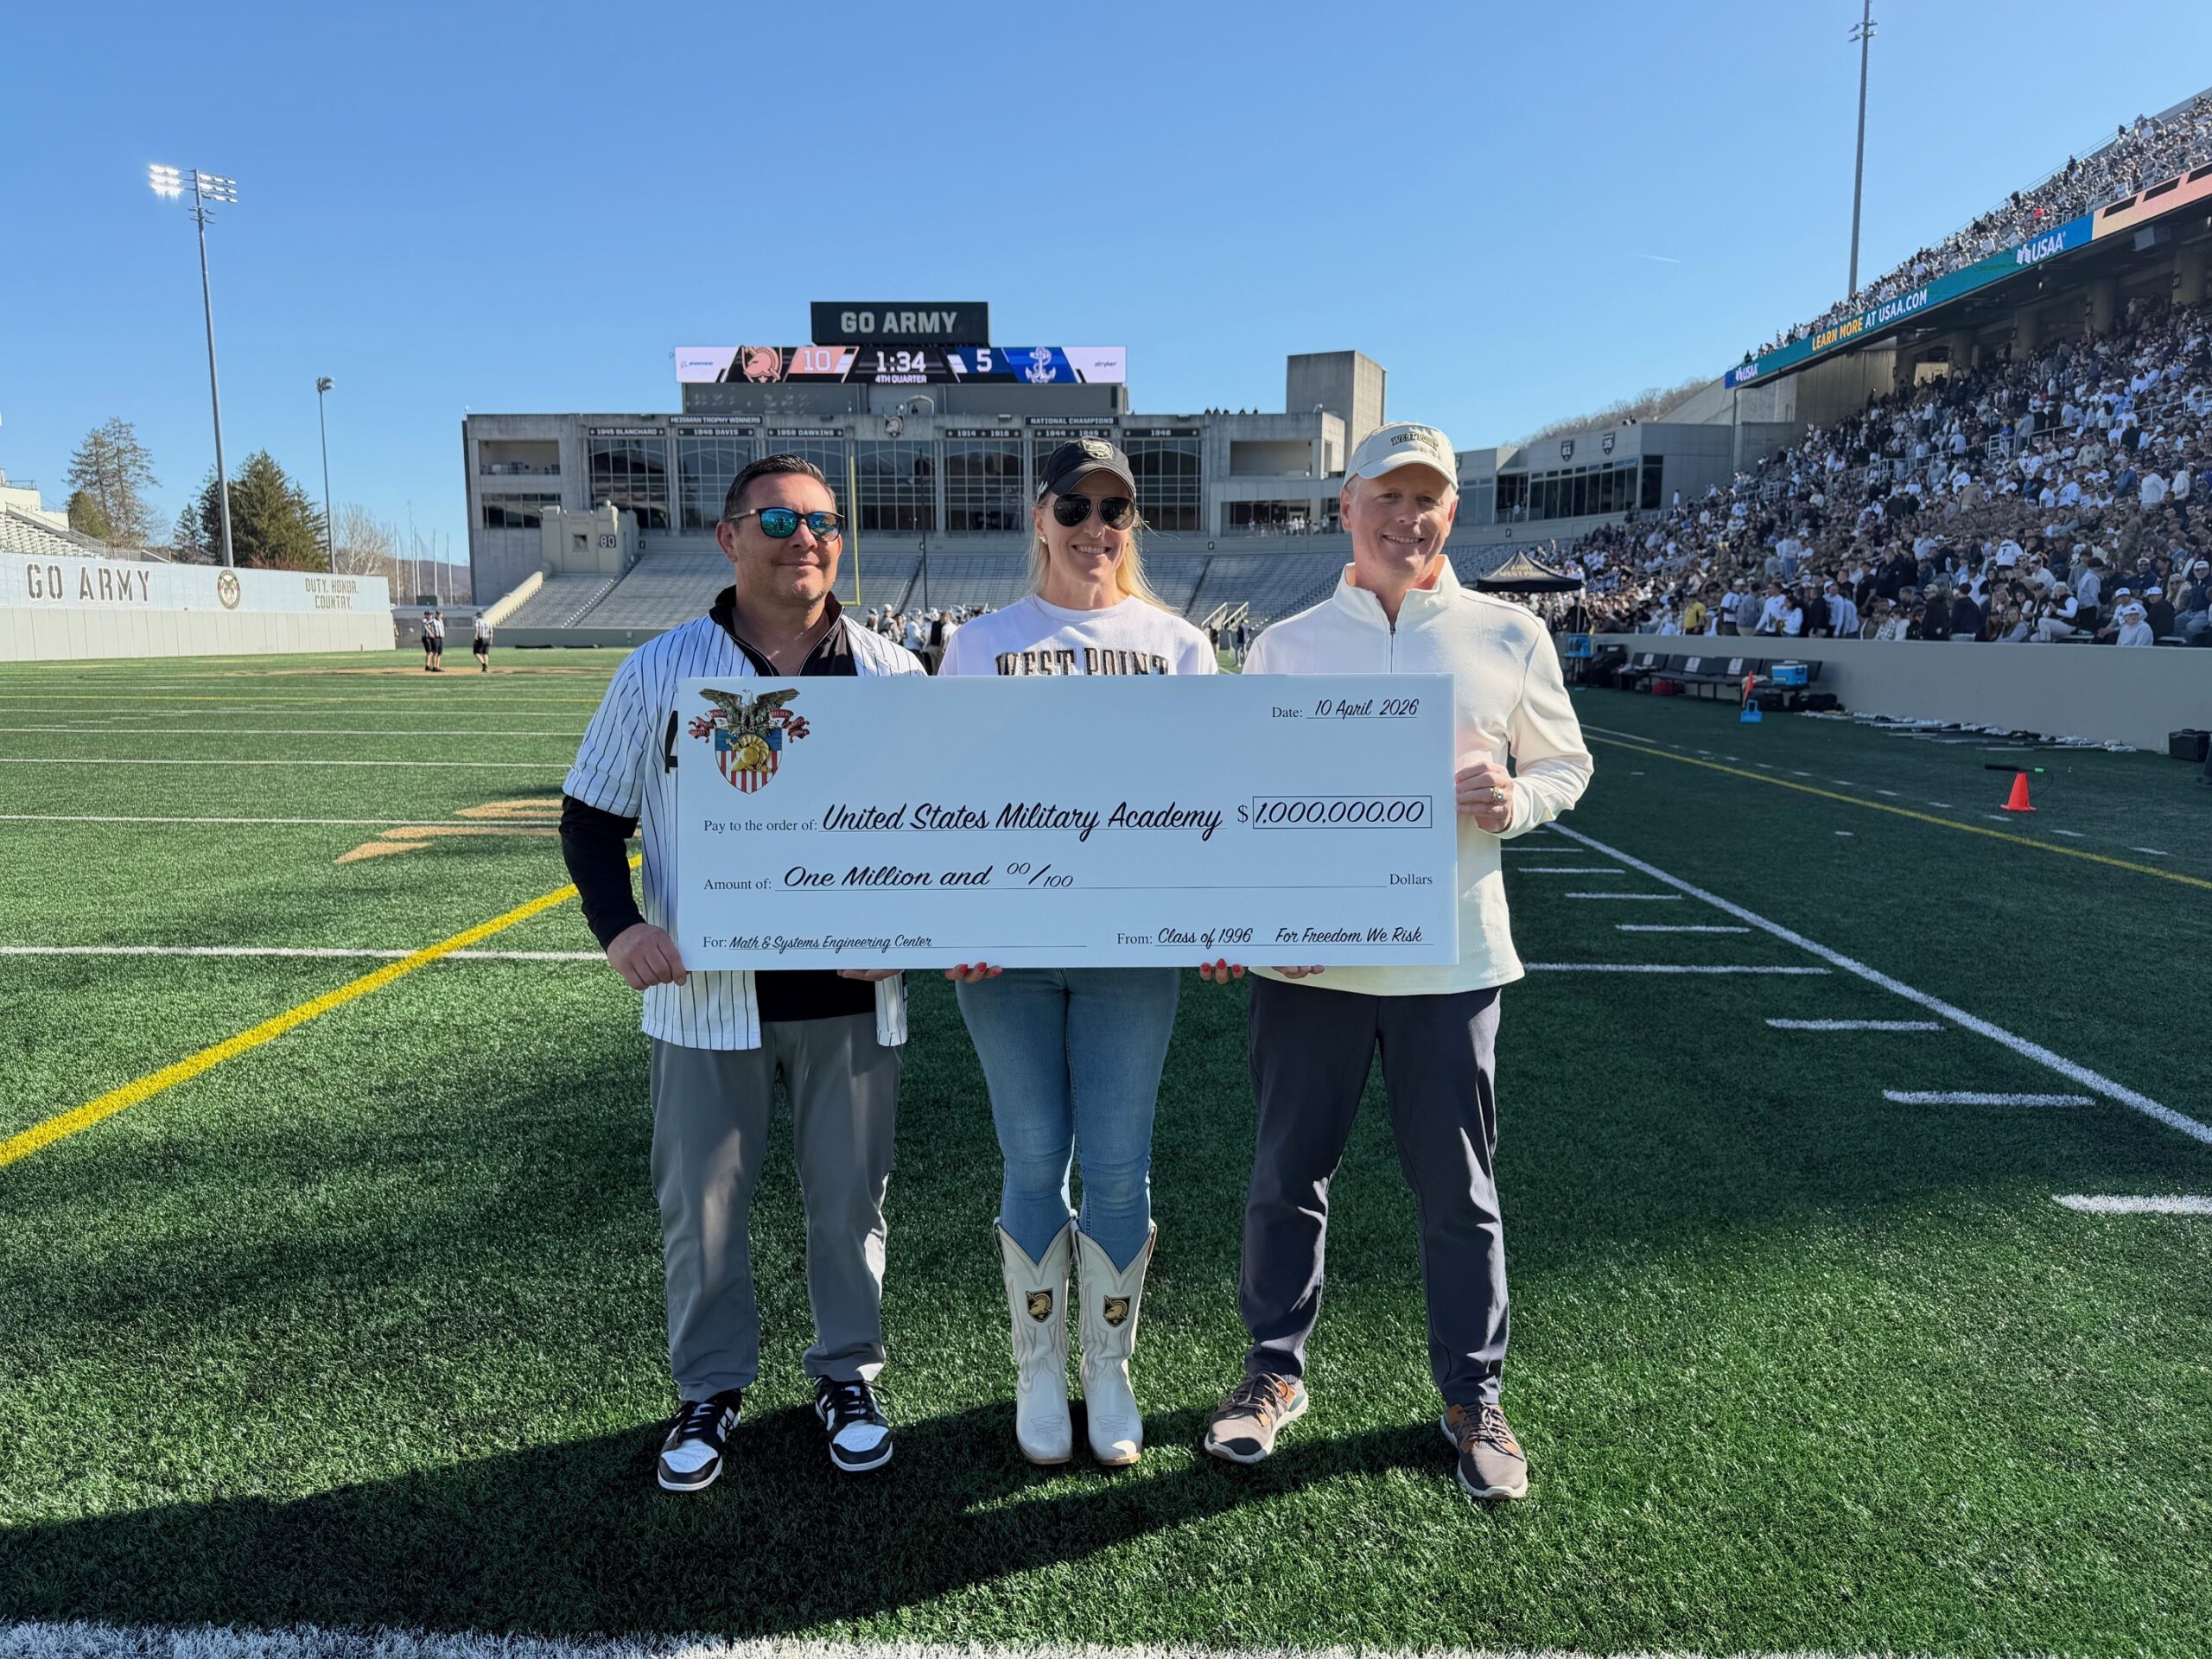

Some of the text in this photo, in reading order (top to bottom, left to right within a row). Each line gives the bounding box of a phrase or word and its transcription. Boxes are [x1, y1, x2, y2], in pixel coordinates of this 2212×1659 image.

[841, 312, 957, 334] GO ARMY
[1812, 289, 1928, 351] LEARN MORE AT USAA.COM
[804, 350, 831, 372] 10
[876, 351, 926, 372] 1:34
[976, 349, 993, 372] 5
[875, 375, 927, 384] 4TH QUARTER
[1390, 432, 1439, 450] WEST POINT
[27, 563, 149, 601] GO ARMY
[305, 577, 359, 594] DUTY. HONOR.
[315, 594, 353, 610] COUNTRY.
[996, 647, 1168, 676] WEST POINT
[1271, 698, 1420, 721] Date: 10 April 2026
[703, 801, 1224, 842] Pay to the order of: United States Military Academy
[1237, 801, 1425, 824] $ 1,000,000.00
[703, 878, 753, 890] Amount
[755, 877, 772, 890] of:
[784, 866, 836, 887] One
[842, 866, 933, 887] Million
[939, 865, 993, 886] and
[1389, 874, 1433, 886] Dollars
[703, 934, 932, 955] For: Math & Systems Engineering Center
[1117, 926, 1422, 950] From: Class of 1996 For Freedom We Risk
